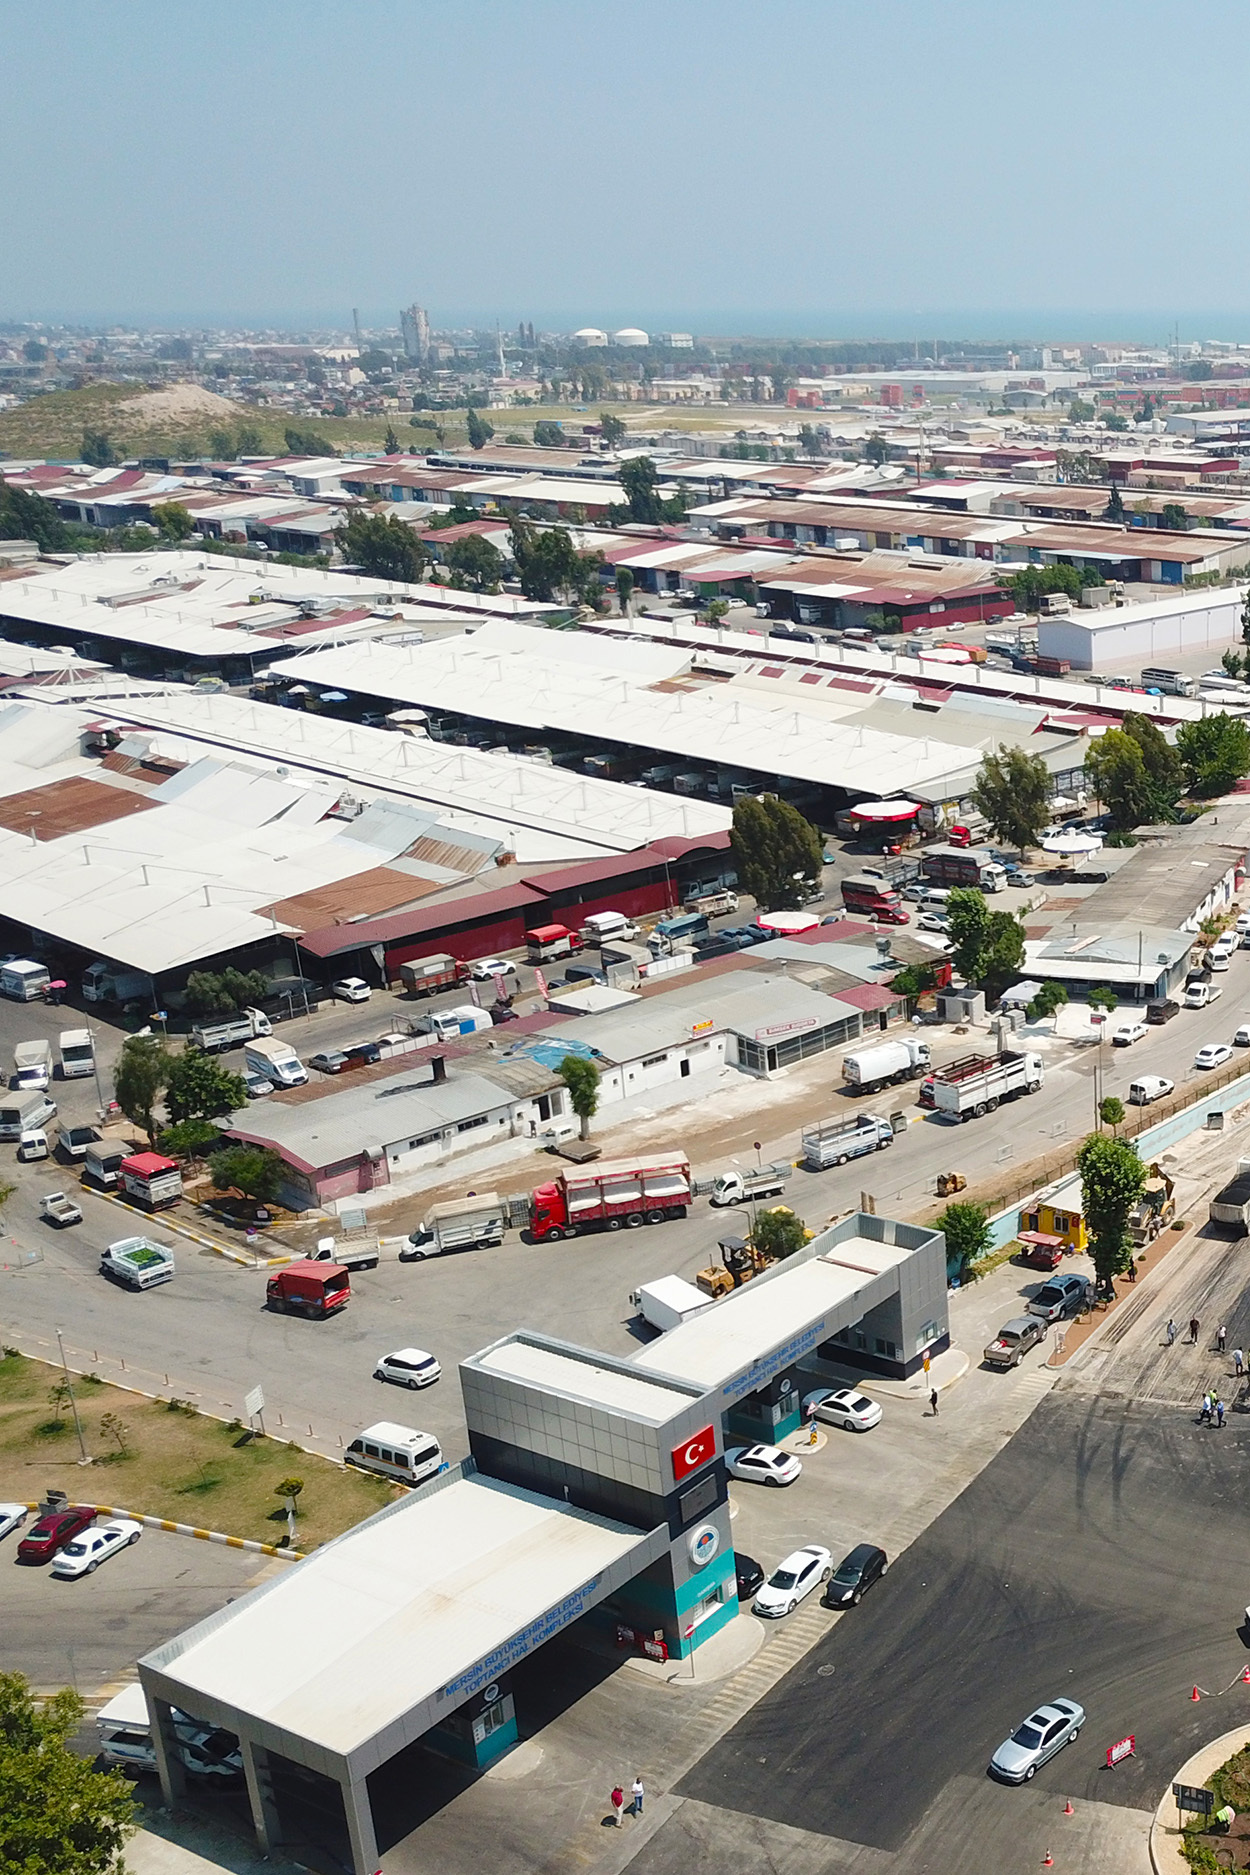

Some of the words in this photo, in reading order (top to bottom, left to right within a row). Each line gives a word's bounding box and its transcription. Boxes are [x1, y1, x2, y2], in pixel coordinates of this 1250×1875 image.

[445, 1664, 483, 1697] MERSİN
[484, 1618, 545, 1668] BÜYÜKŞEHİR
[545, 1579, 597, 1624] BELEDİYESİ
[464, 1657, 511, 1696] TOPTANCI
[512, 1643, 530, 1661] HAL
[532, 1601, 584, 1646] KOMPLEKSİ
